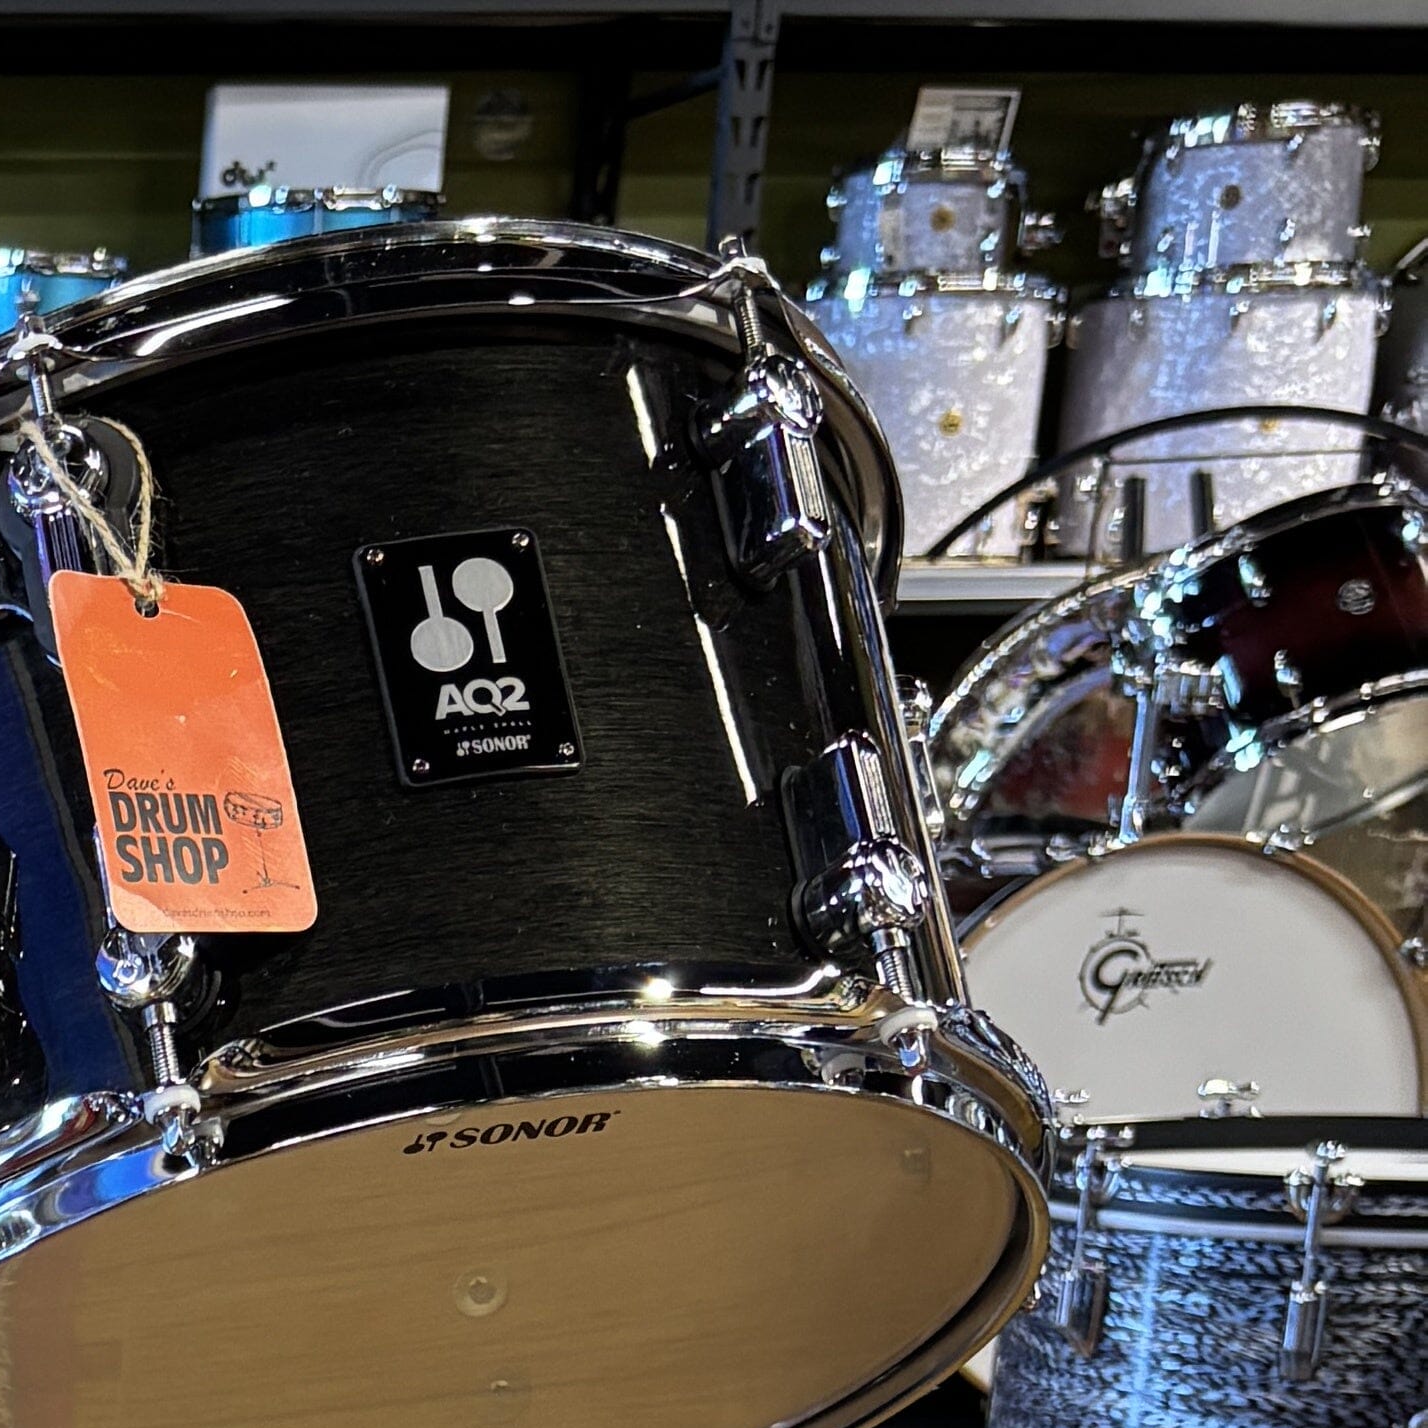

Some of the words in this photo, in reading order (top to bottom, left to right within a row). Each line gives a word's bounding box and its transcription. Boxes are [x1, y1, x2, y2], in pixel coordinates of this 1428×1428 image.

[434, 676, 531, 720] AQ2
[103, 768, 176, 791] Dave's
[108, 791, 224, 836] DRUM
[114, 834, 230, 885] SHOP
[449, 1111, 613, 1149] SONOR
